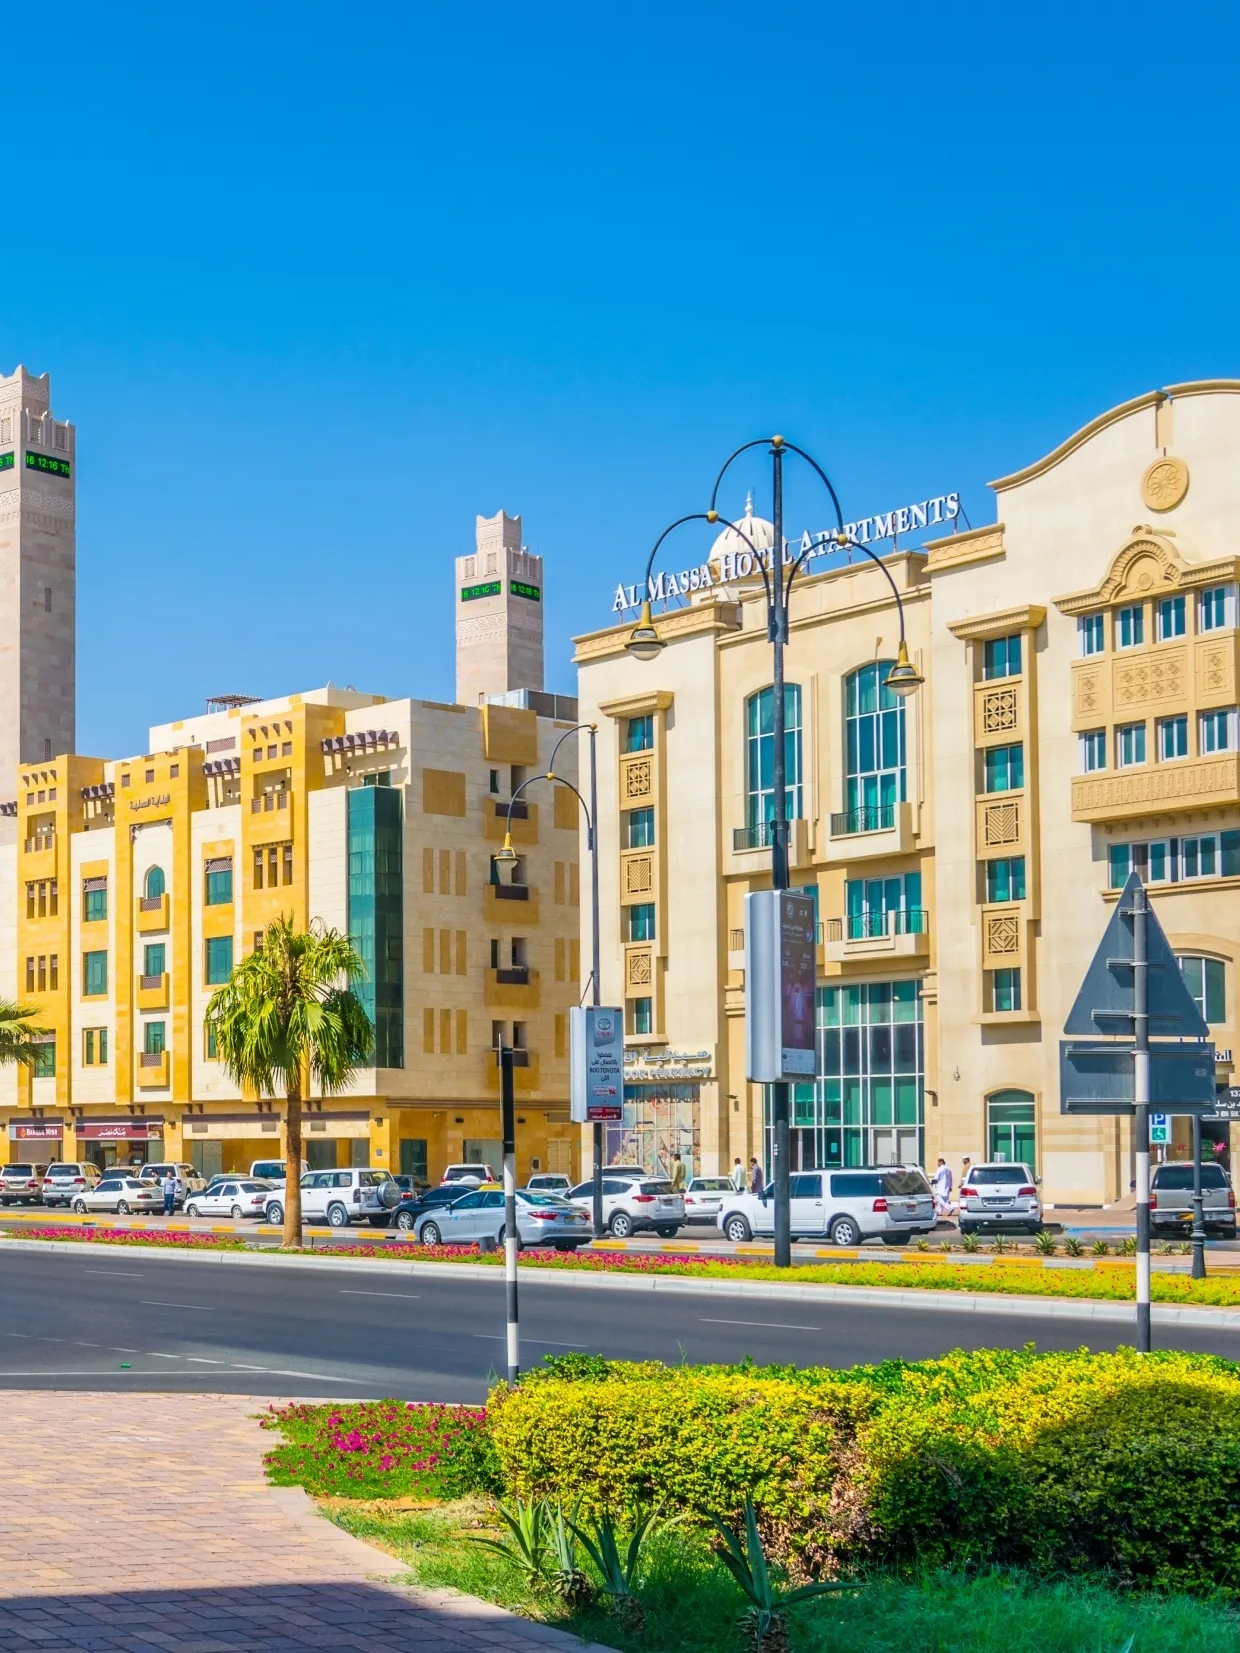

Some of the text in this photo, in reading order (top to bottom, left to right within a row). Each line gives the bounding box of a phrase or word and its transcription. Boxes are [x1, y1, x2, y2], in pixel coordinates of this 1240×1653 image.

[38, 457, 58, 470] 12:16
[612, 583, 641, 612] AL
[647, 564, 713, 602] MASSA
[720, 543, 794, 582] HOTL
[642, 1046, 709, 1065] صيدلية
[650, 1067, 711, 1078] PHARMACY
[1153, 1114, 1165, 1124] P
[26, 1128, 45, 1136] BANQUE
